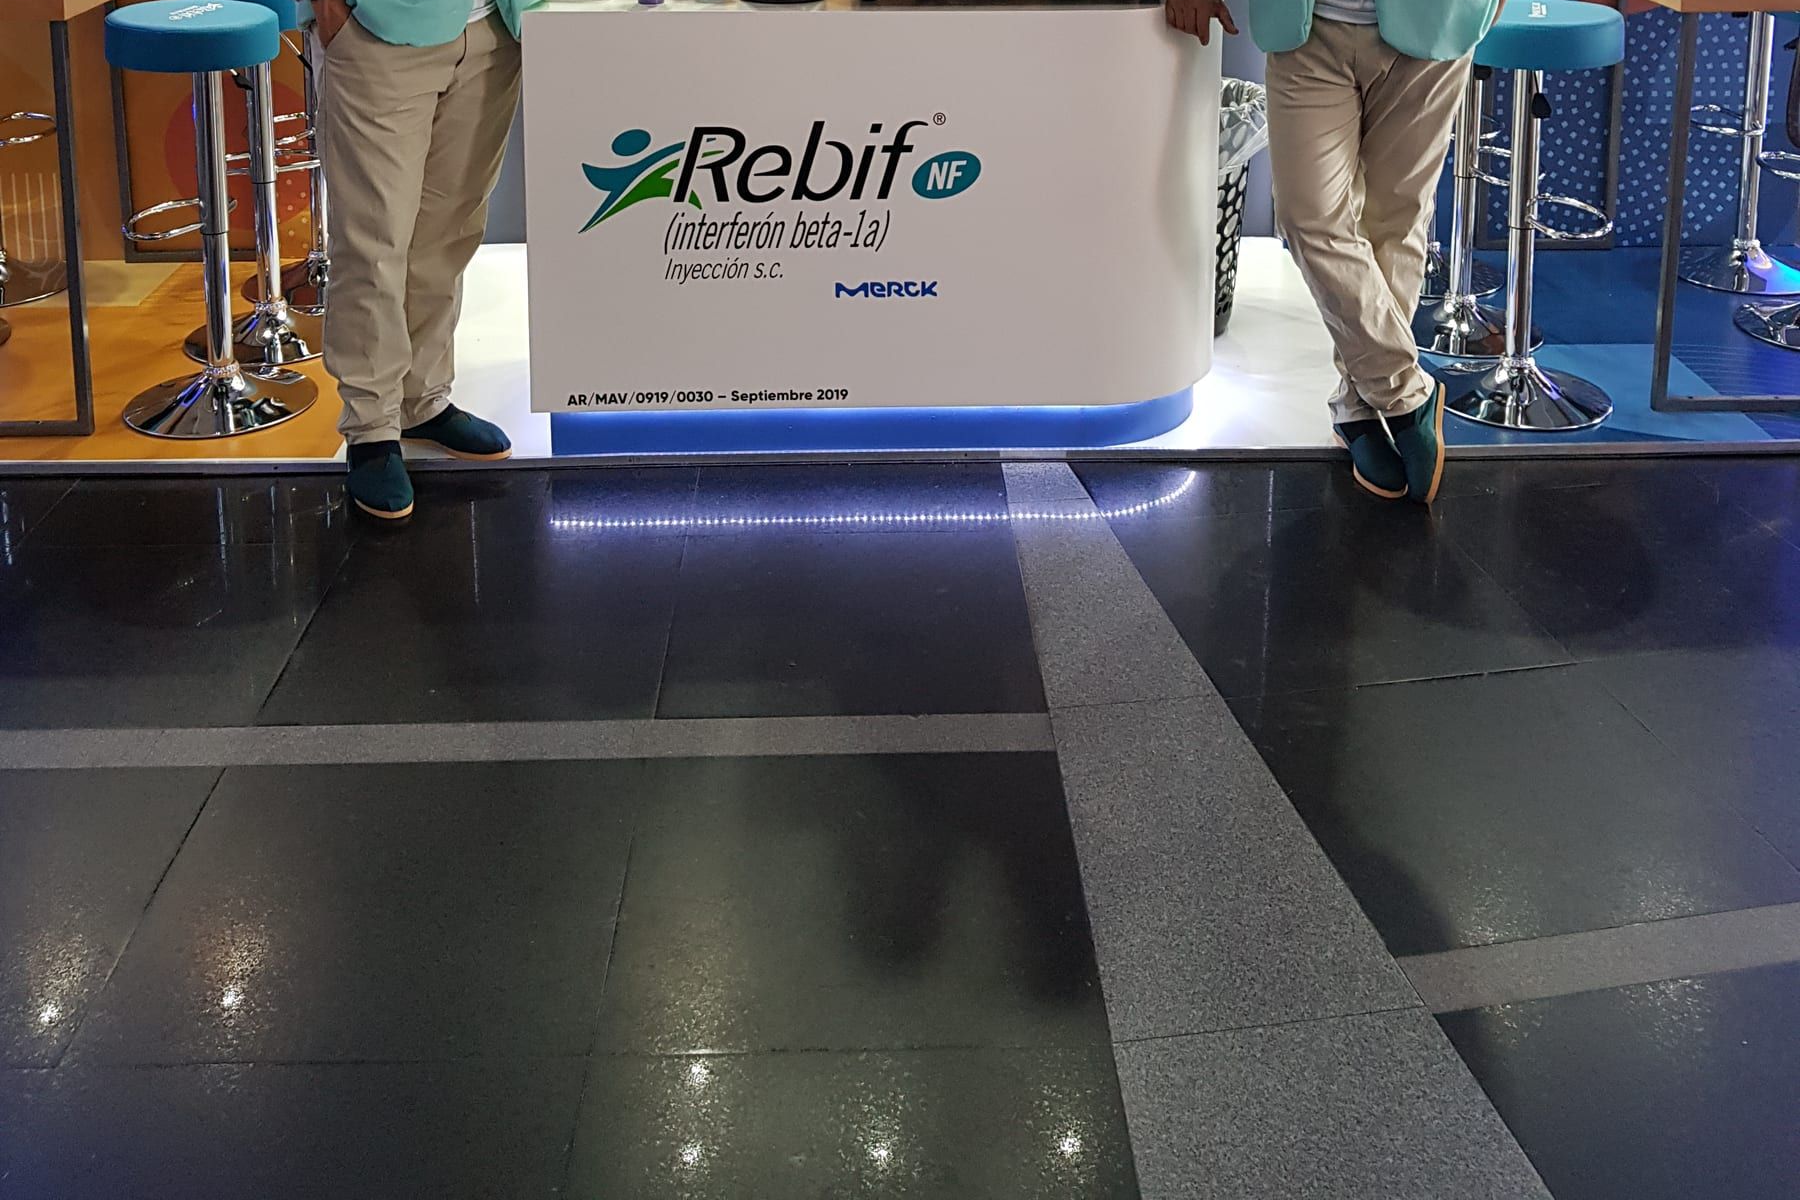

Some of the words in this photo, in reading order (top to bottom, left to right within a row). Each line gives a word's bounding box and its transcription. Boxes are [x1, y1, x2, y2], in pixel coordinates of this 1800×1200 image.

[926, 160, 967, 191] NF
[664, 211, 786, 254] (interferón
[789, 209, 890, 252] beta-1a)
[665, 258, 749, 285] Inyección
[754, 262, 784, 280] s.c.
[567, 390, 714, 407] AR/MAV/0919/0030
[731, 389, 813, 405] Septiembre
[816, 389, 849, 401] 2019
